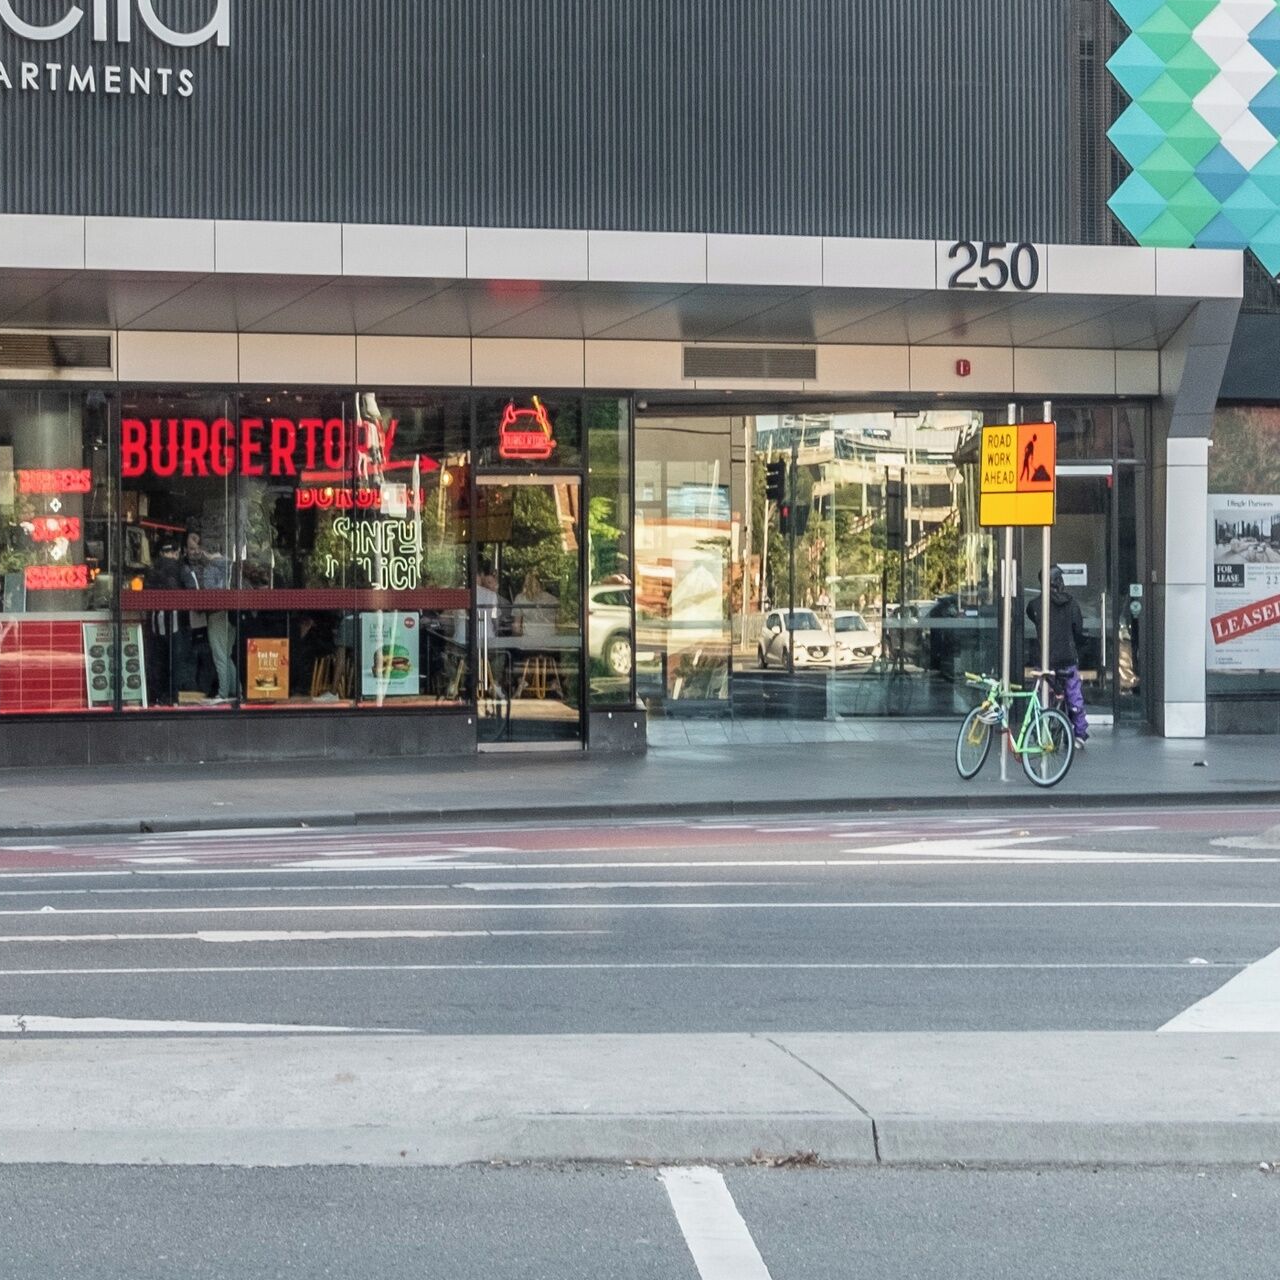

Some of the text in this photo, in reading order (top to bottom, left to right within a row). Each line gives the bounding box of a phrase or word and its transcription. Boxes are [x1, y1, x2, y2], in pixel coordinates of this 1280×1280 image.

[948, 241, 1039, 291] 250
[987, 434, 1012, 448] ROAD
[987, 453, 1011, 466] WORK
[984, 470, 1015, 484] AHEAD
[1216, 565, 1233, 574] FOR
[1216, 574, 1240, 583] LEASE
